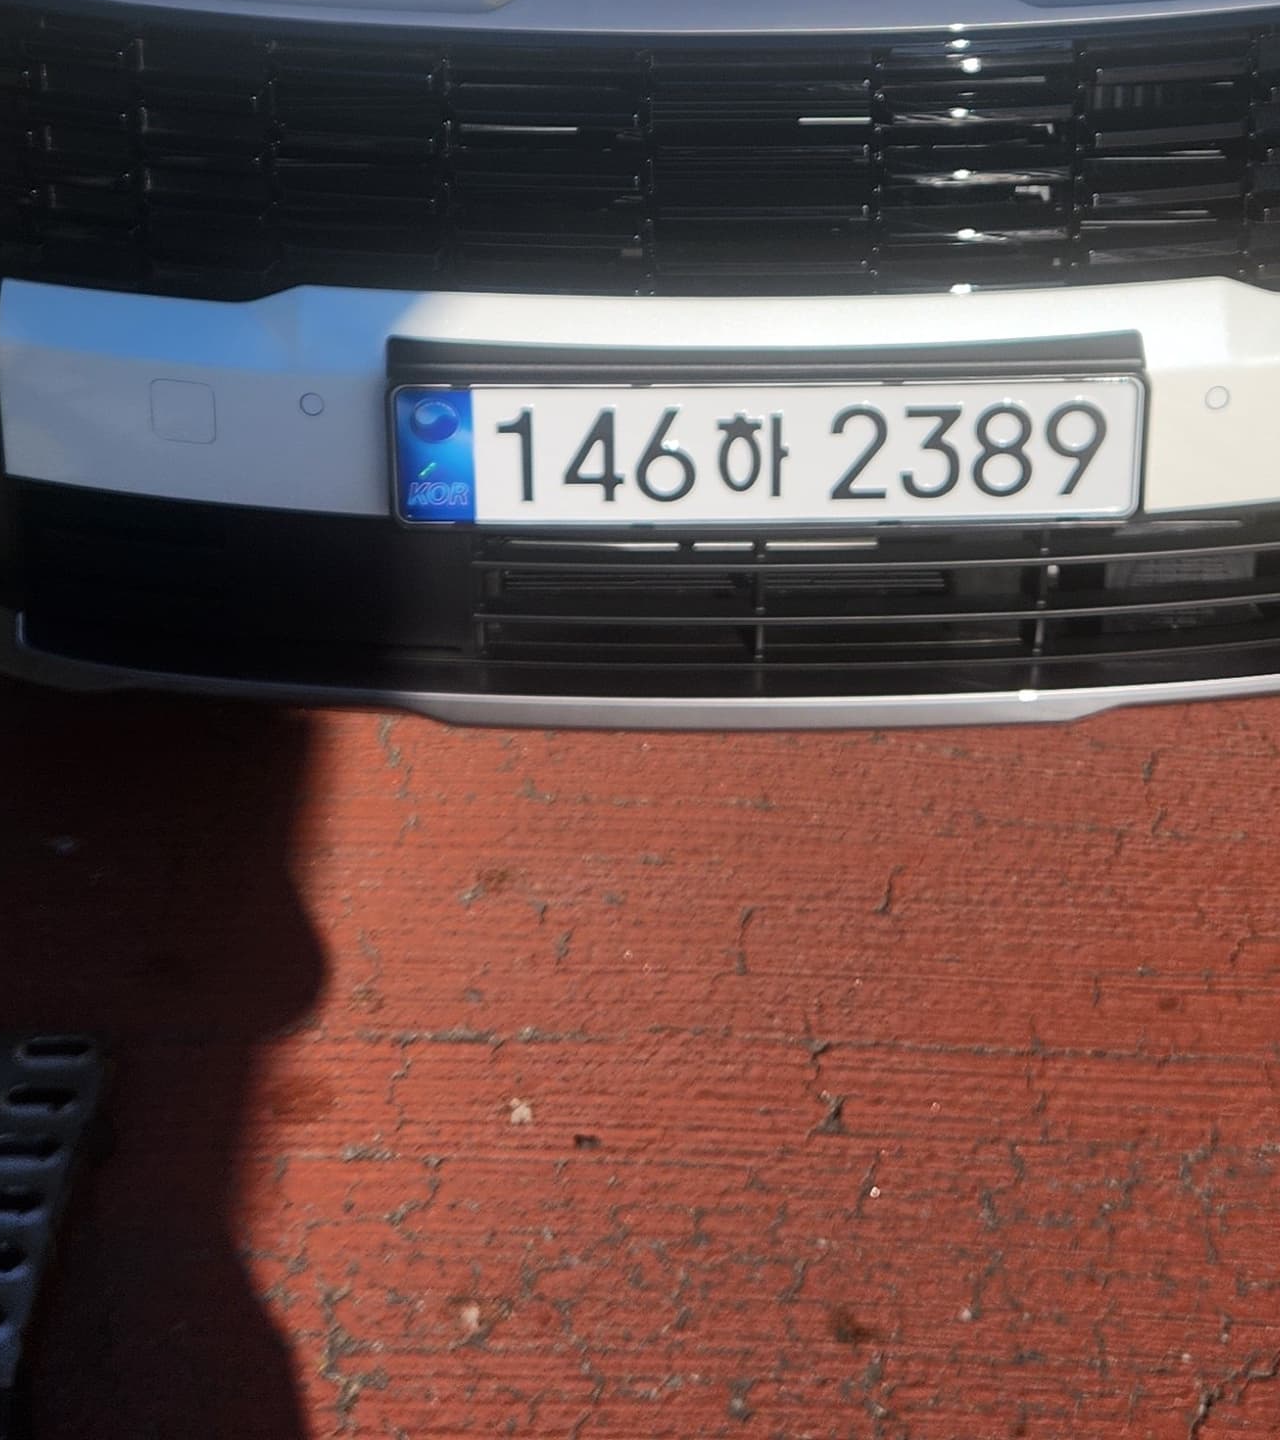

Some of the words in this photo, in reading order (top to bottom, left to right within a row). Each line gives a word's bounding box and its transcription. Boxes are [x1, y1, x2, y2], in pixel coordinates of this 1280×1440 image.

[495, 405, 789, 503] 146하
[829, 399, 1108, 500] 2389
[407, 480, 471, 507] KOR
